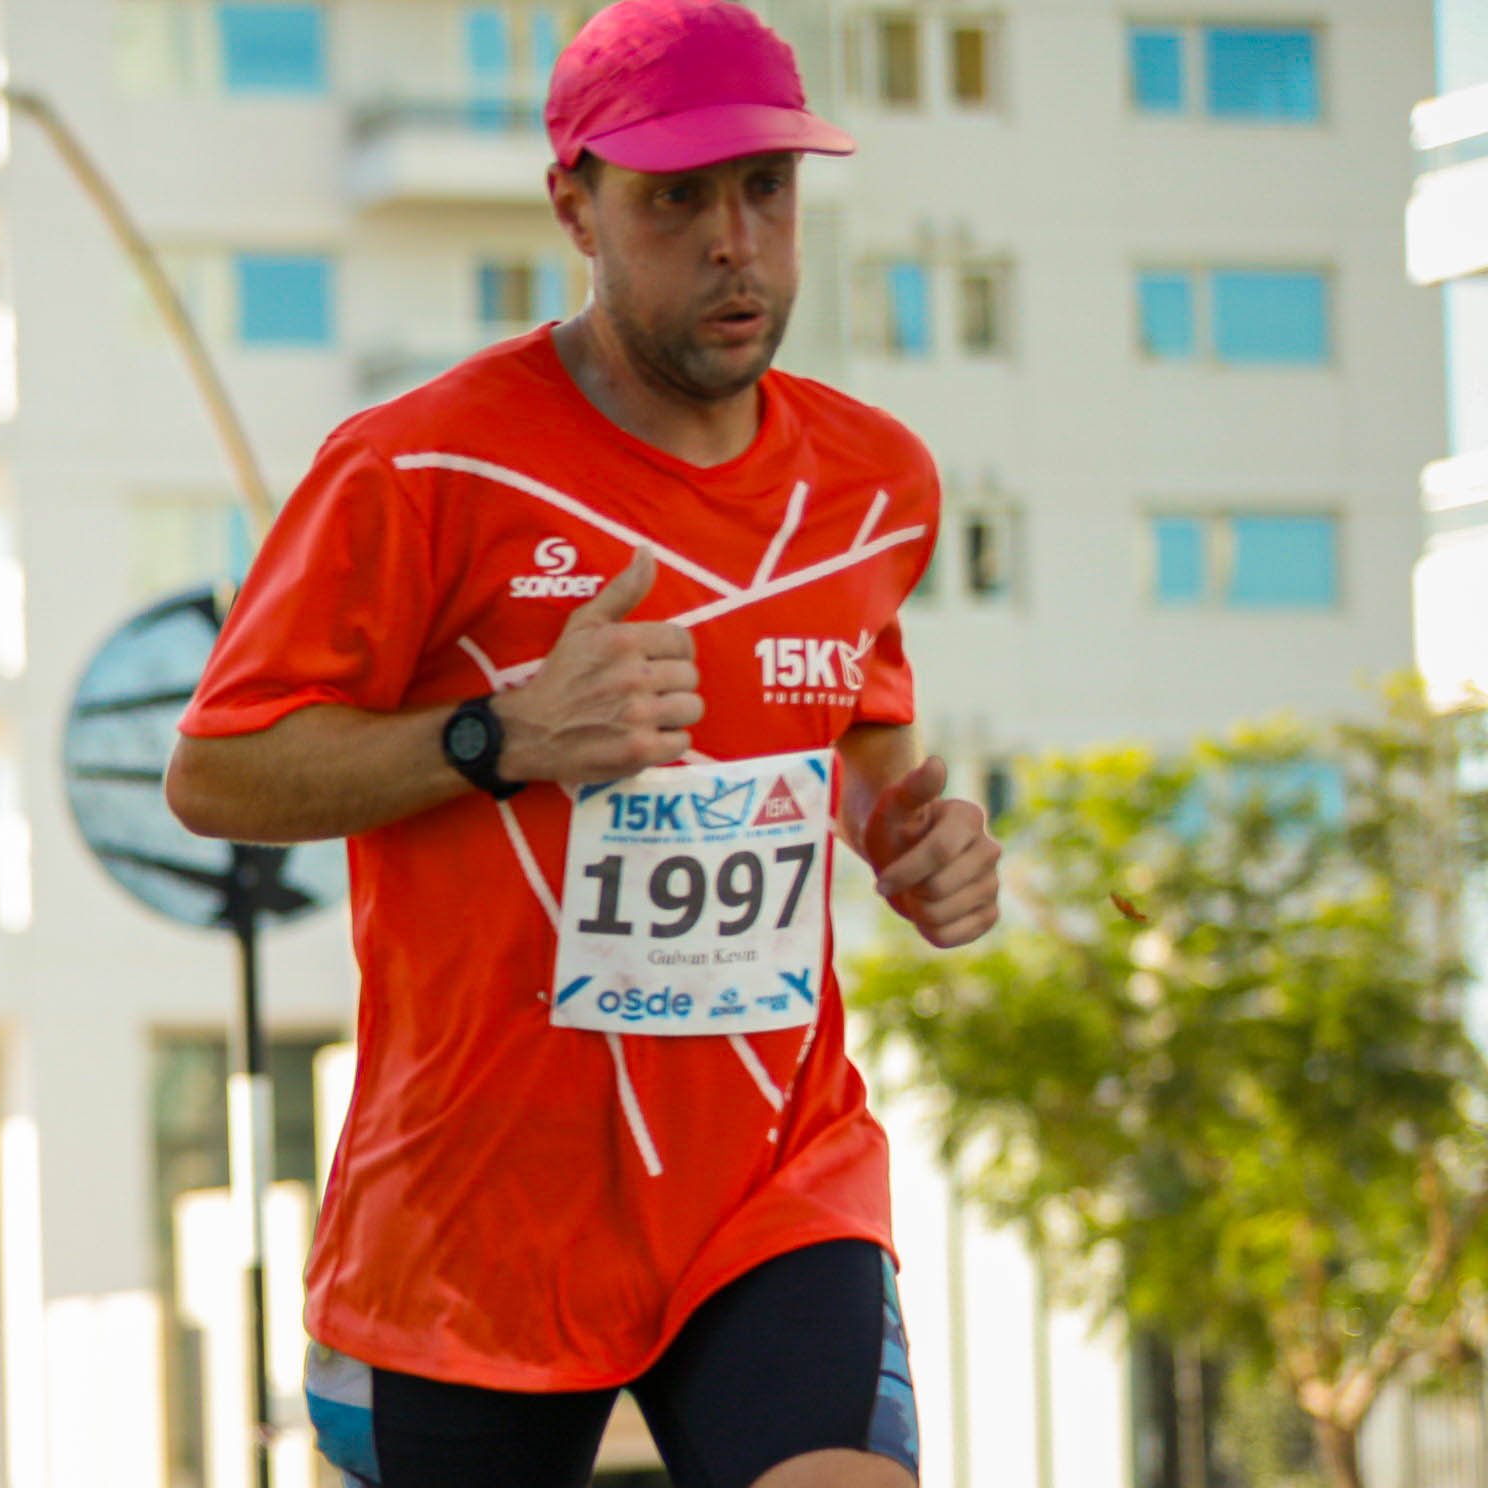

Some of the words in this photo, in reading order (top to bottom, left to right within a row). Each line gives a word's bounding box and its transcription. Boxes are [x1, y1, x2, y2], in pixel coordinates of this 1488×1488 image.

[754, 638, 838, 687] 15K
[608, 793, 684, 831] 15K
[578, 842, 816, 938] 1997
